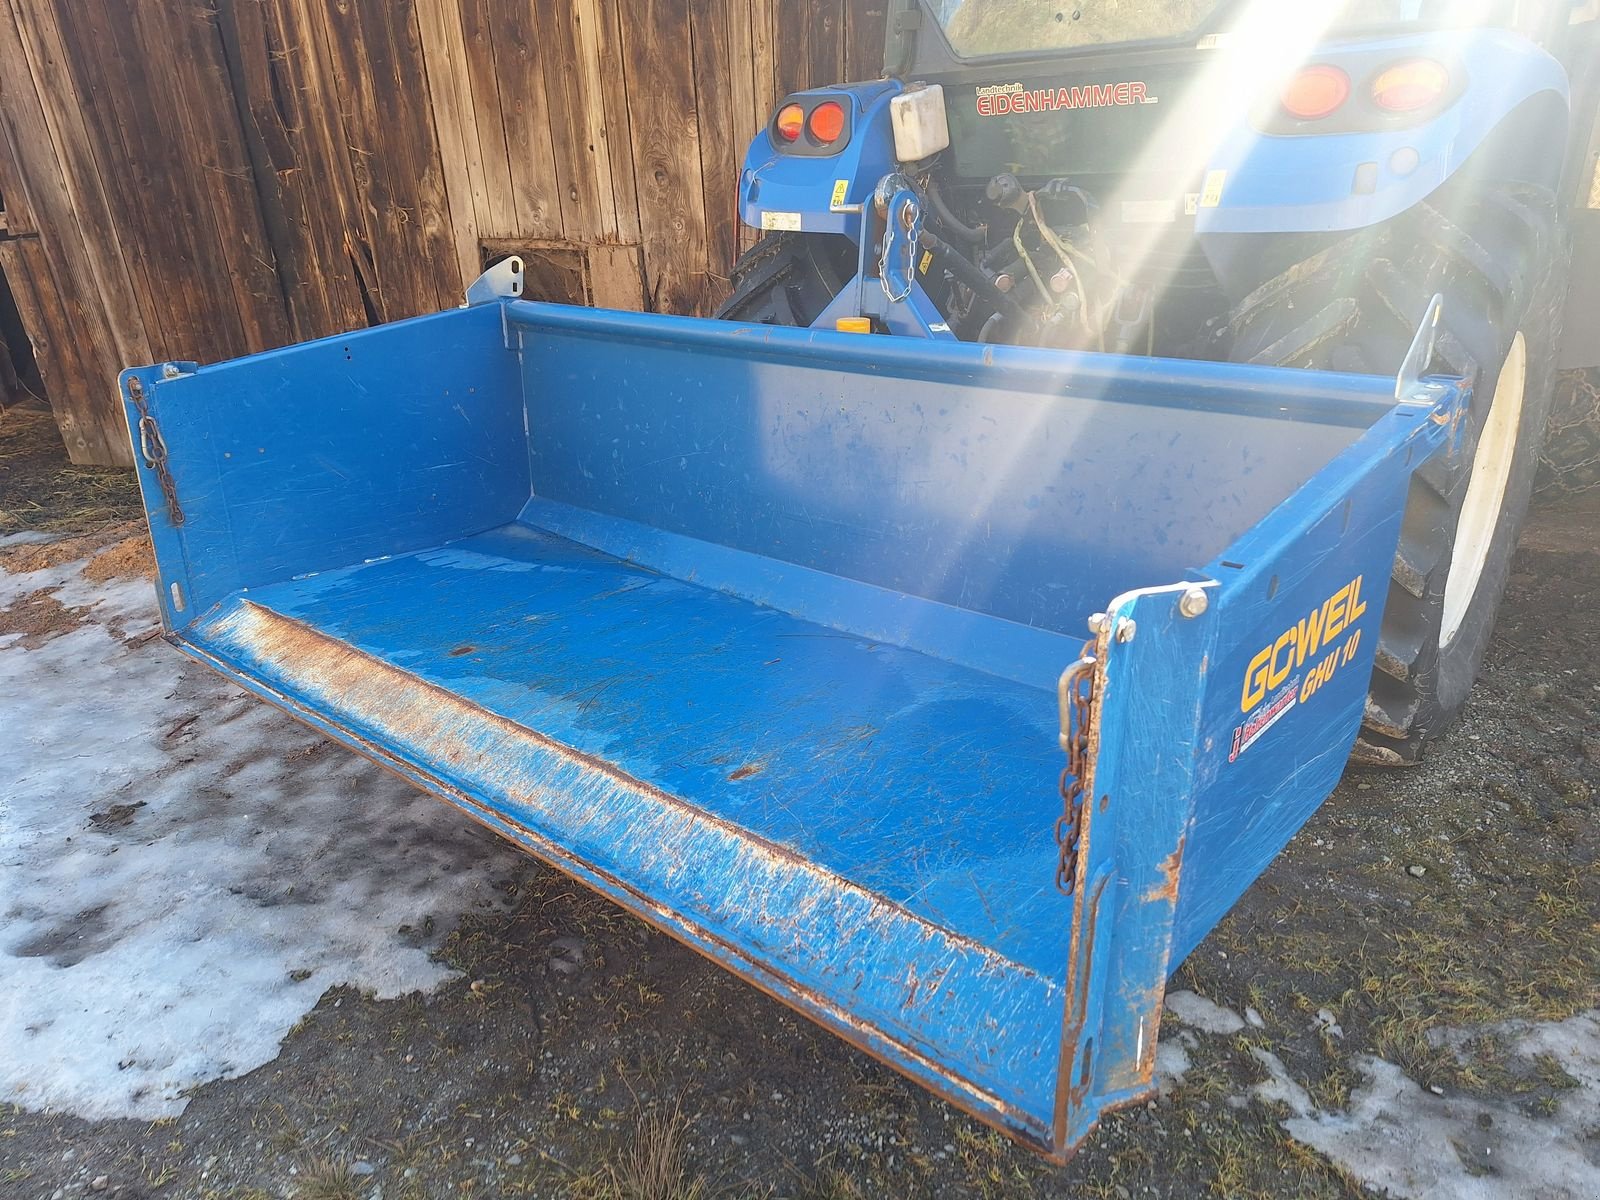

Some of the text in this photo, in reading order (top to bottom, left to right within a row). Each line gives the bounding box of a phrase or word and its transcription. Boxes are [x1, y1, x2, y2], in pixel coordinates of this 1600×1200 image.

[976, 82, 1024, 96] Landtechnik
[976, 82, 1147, 116] EIDENHAMMER
[1300, 646, 1341, 704] GHU
[1341, 629, 1361, 668] 10
